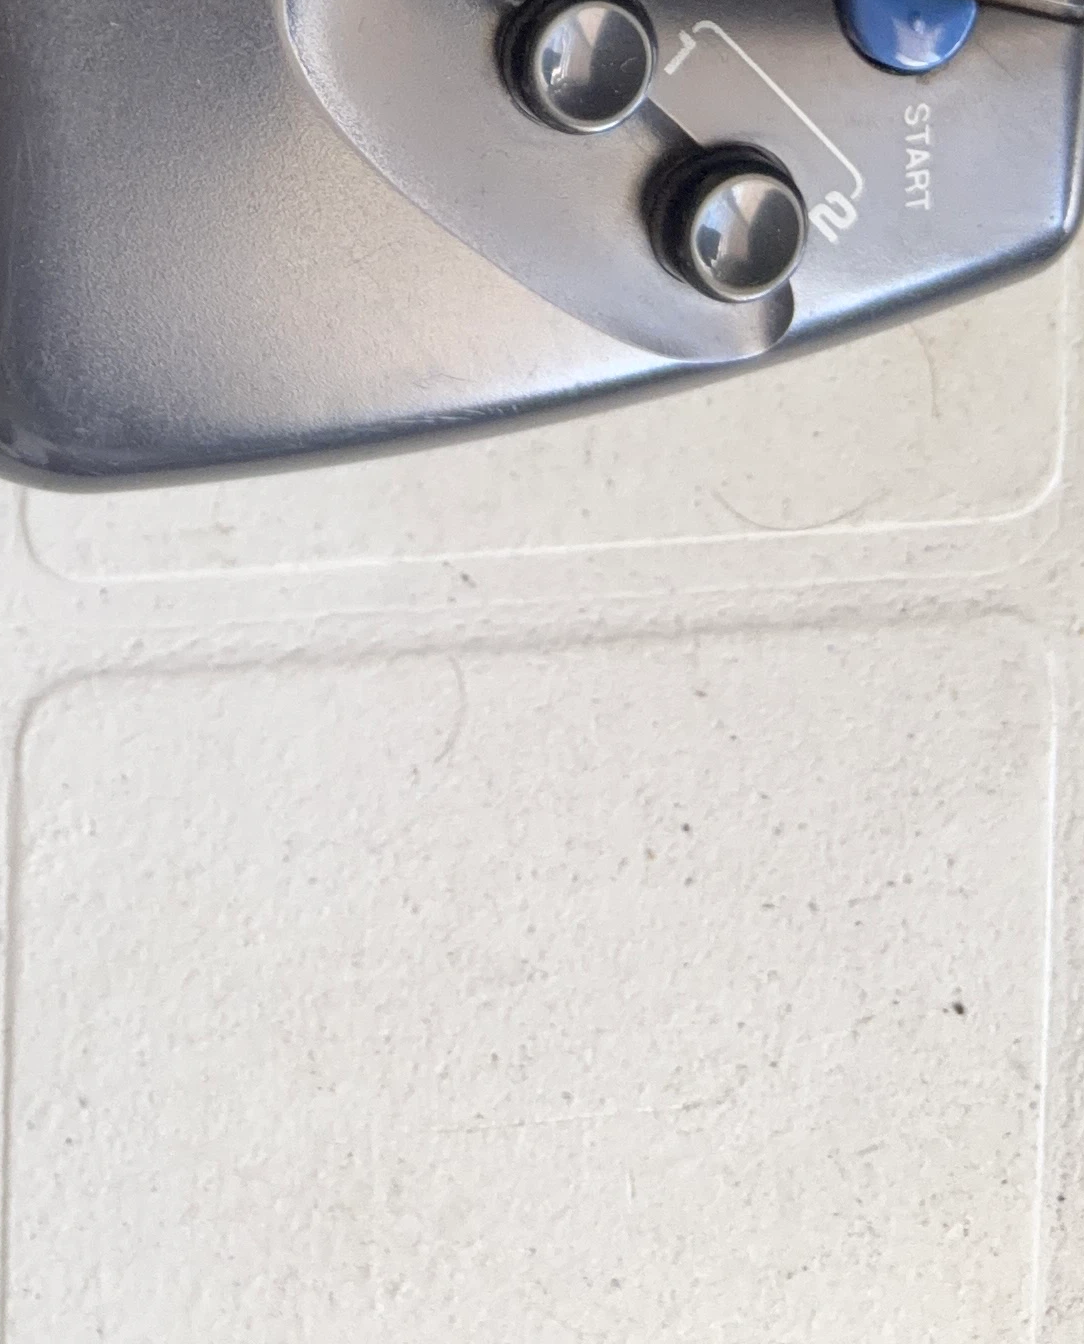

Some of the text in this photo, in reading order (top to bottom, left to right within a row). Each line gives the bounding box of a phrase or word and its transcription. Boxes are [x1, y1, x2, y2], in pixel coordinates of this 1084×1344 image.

[664, 30, 696, 75] 1
[903, 103, 932, 211] START
[808, 190, 859, 244] 2
